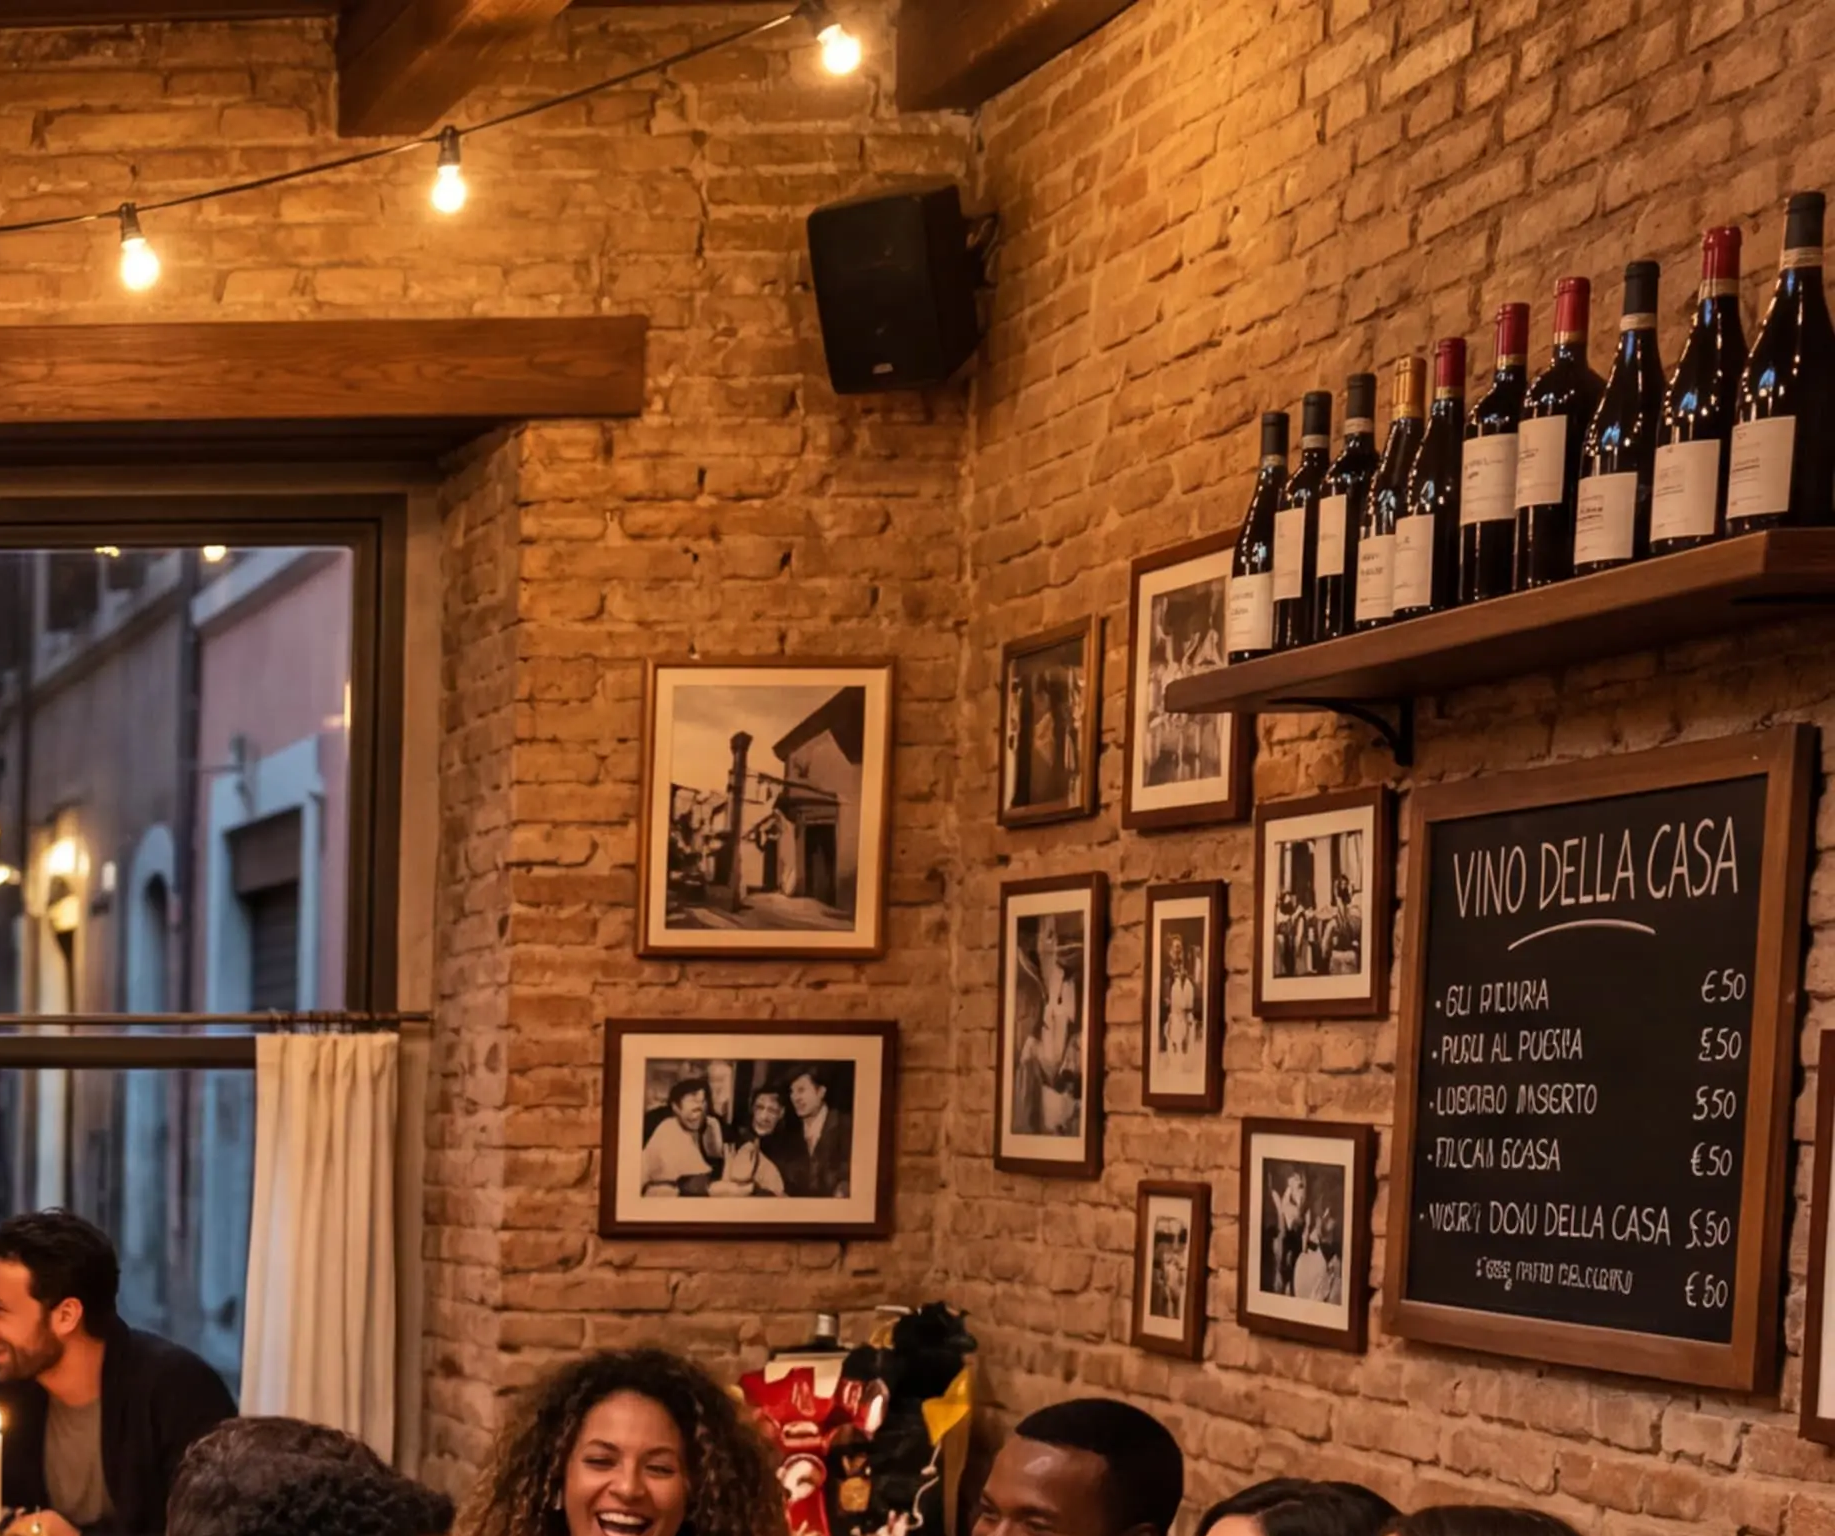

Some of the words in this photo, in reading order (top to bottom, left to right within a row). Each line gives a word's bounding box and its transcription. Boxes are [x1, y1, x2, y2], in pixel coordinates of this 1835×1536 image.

[1453, 845, 1527, 918] VINO
[1539, 829, 1635, 910] DELLA
[1646, 816, 1738, 900] CASA
[1701, 968, 1746, 1003] €50
[1490, 1033, 1513, 1063] AL
[1544, 1202, 1604, 1240] DELLA
[1611, 1204, 1671, 1246] CASA
